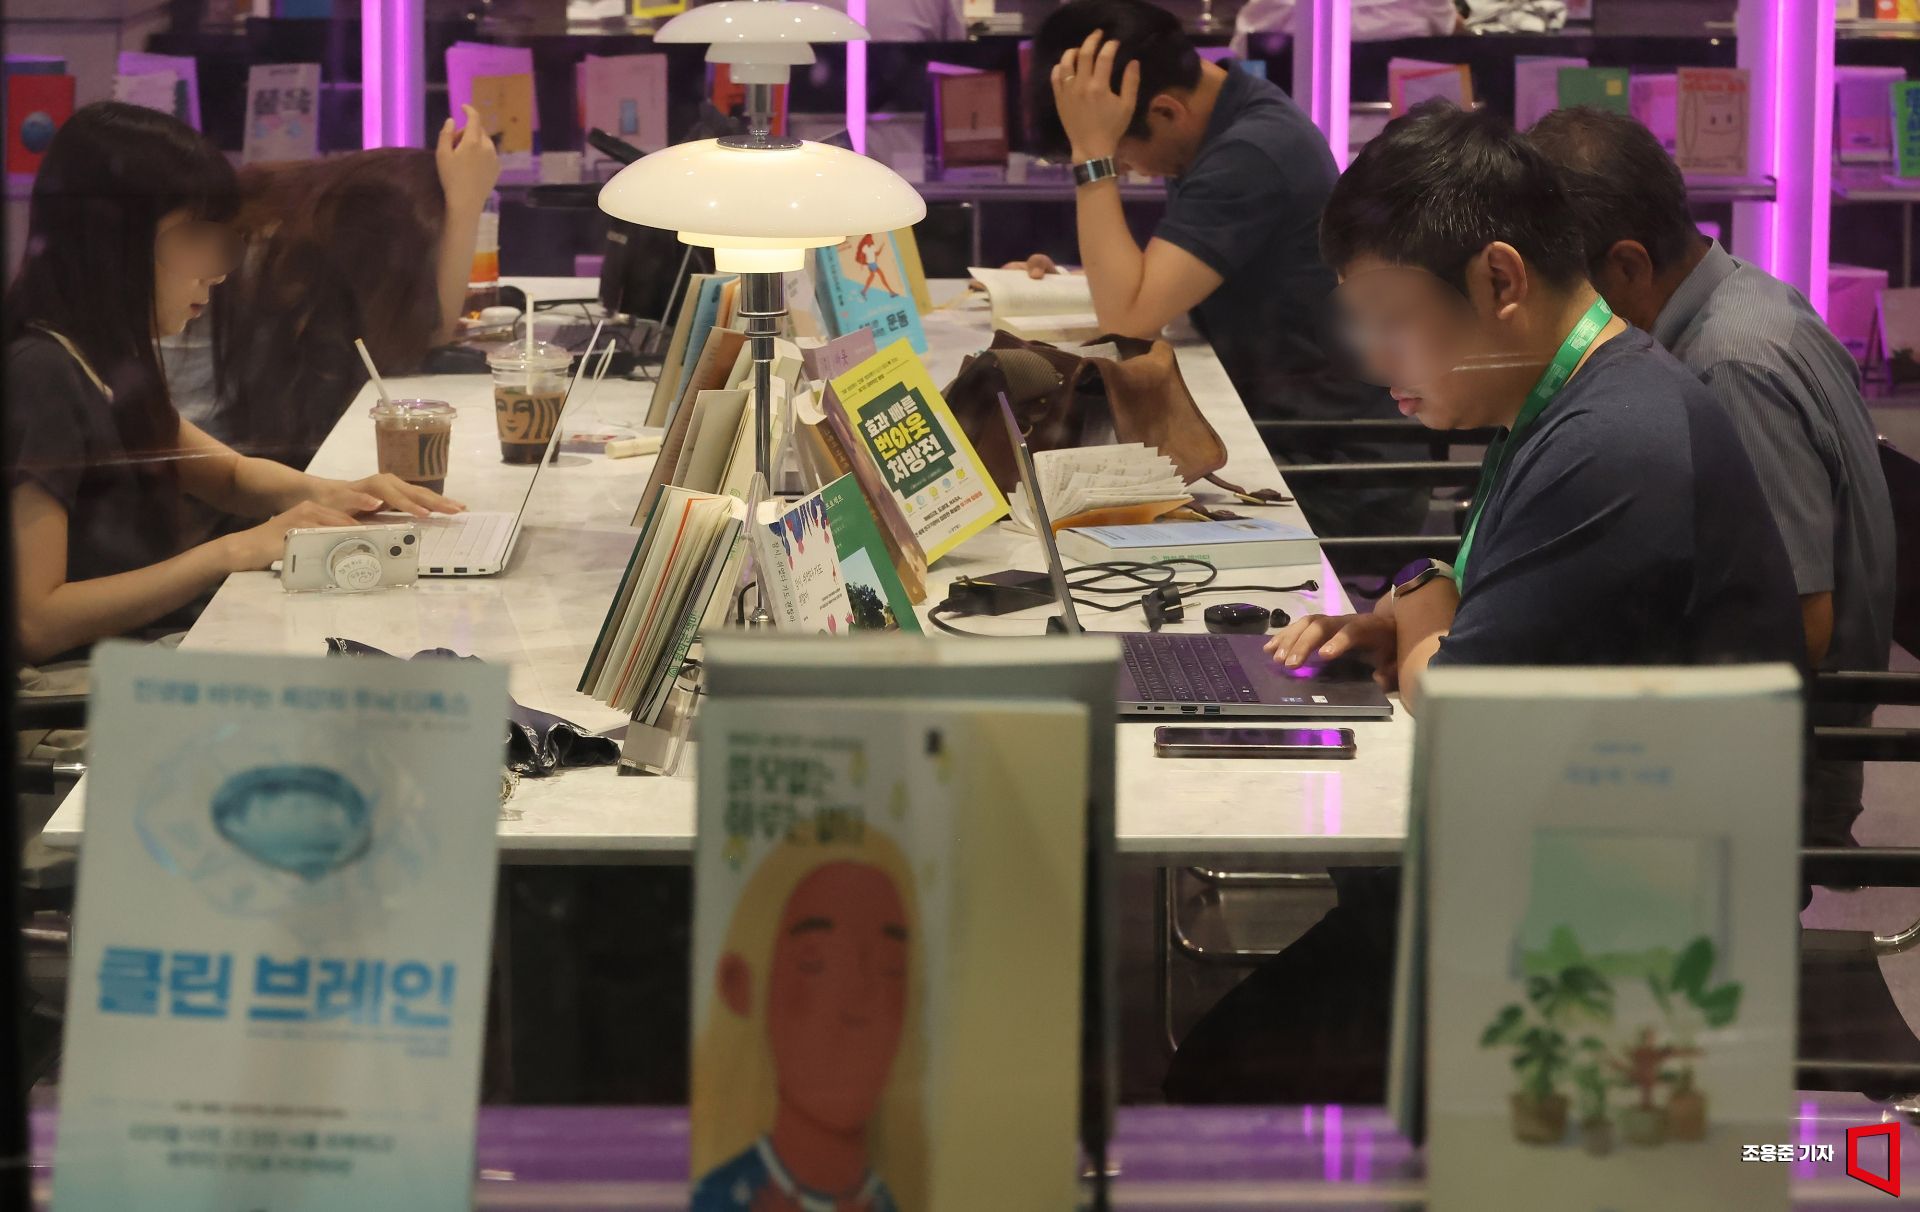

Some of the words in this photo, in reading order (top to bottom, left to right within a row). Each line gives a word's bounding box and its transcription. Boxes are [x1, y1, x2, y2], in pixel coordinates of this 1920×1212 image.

[886, 310, 909, 332] 운동
[865, 411, 891, 439] 효과
[887, 394, 918, 424] 빠른
[873, 412, 931, 461] 번아웃
[886, 433, 946, 484] 처방전
[96, 945, 234, 1019] 클린
[246, 953, 459, 1028] 브레인
